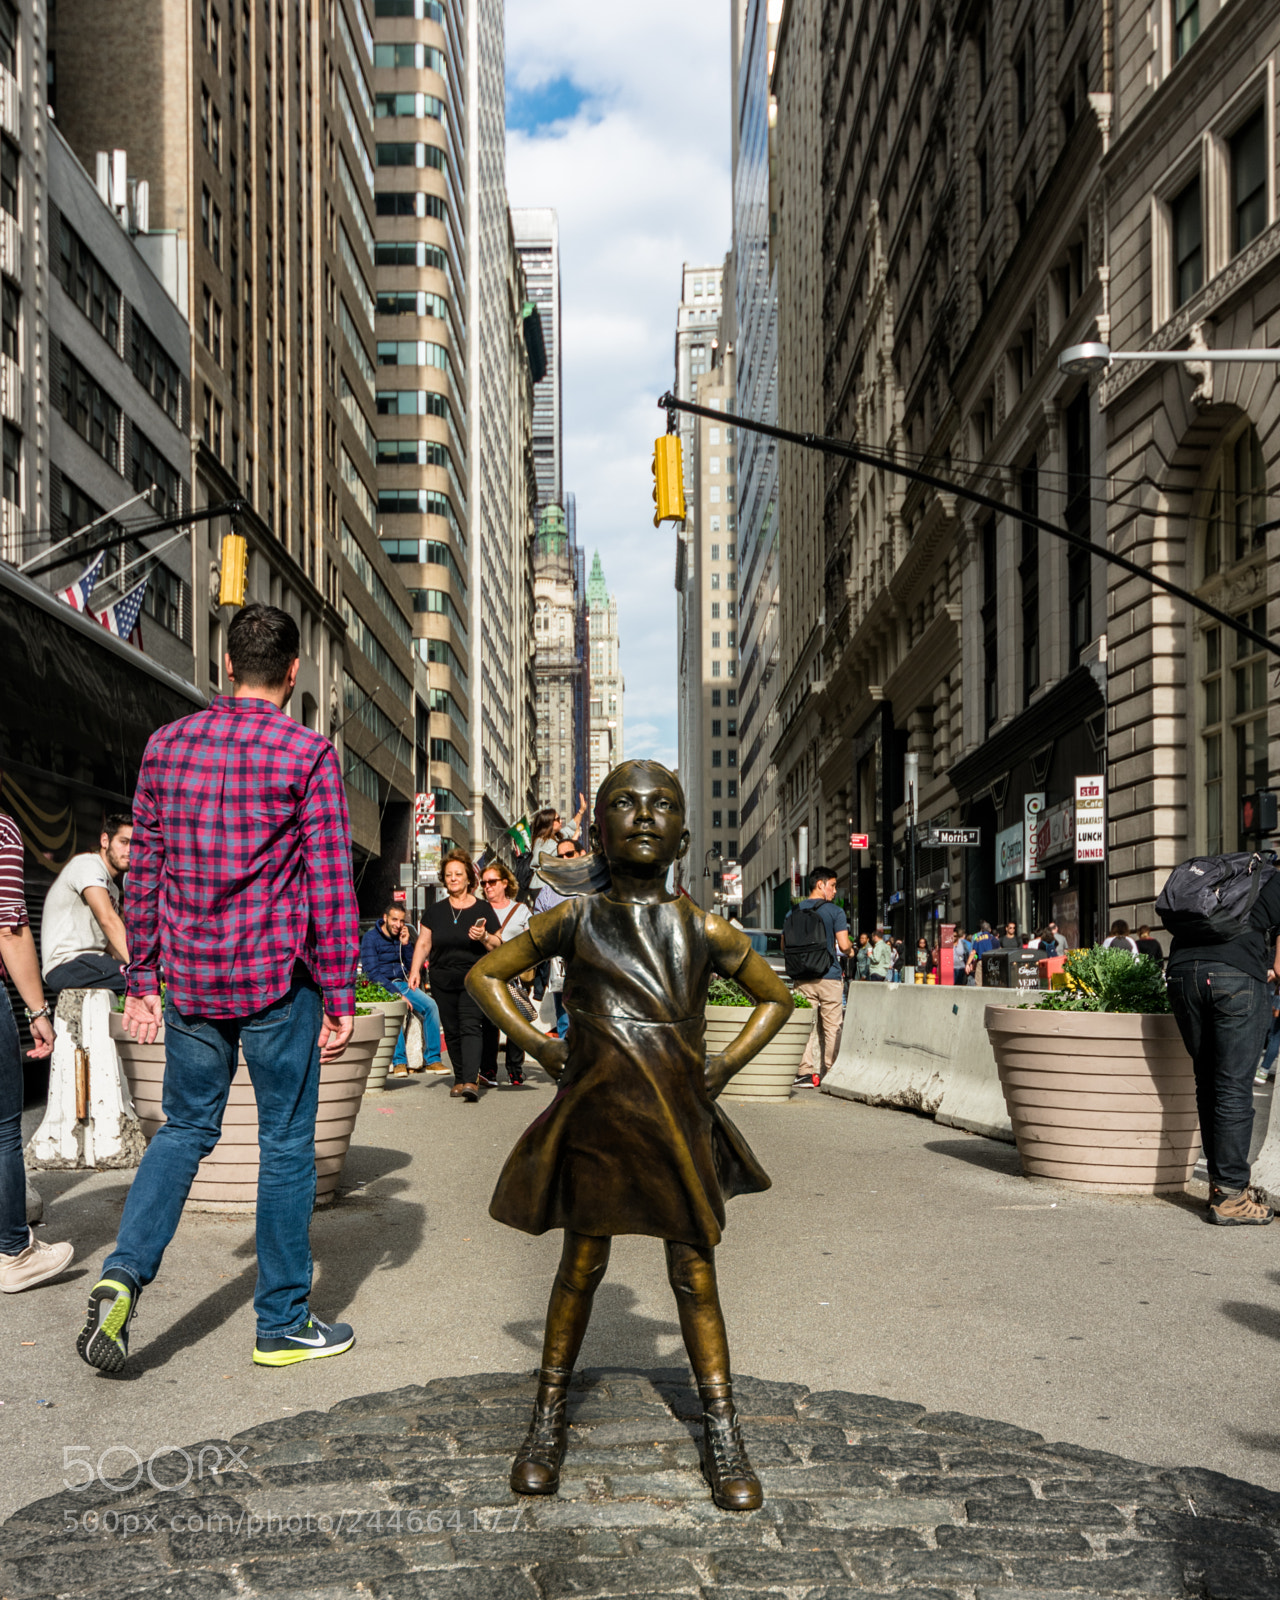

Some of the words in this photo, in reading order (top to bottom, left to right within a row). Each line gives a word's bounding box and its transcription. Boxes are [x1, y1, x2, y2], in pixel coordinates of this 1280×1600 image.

[1081, 783, 1099, 796] stir
[1063, 808, 1073, 840] Ca
[1076, 816, 1103, 825] BREAKFAST
[941, 832, 968, 843] Morris
[1078, 832, 1103, 841] LUNCH
[1077, 848, 1103, 859] DINNER
